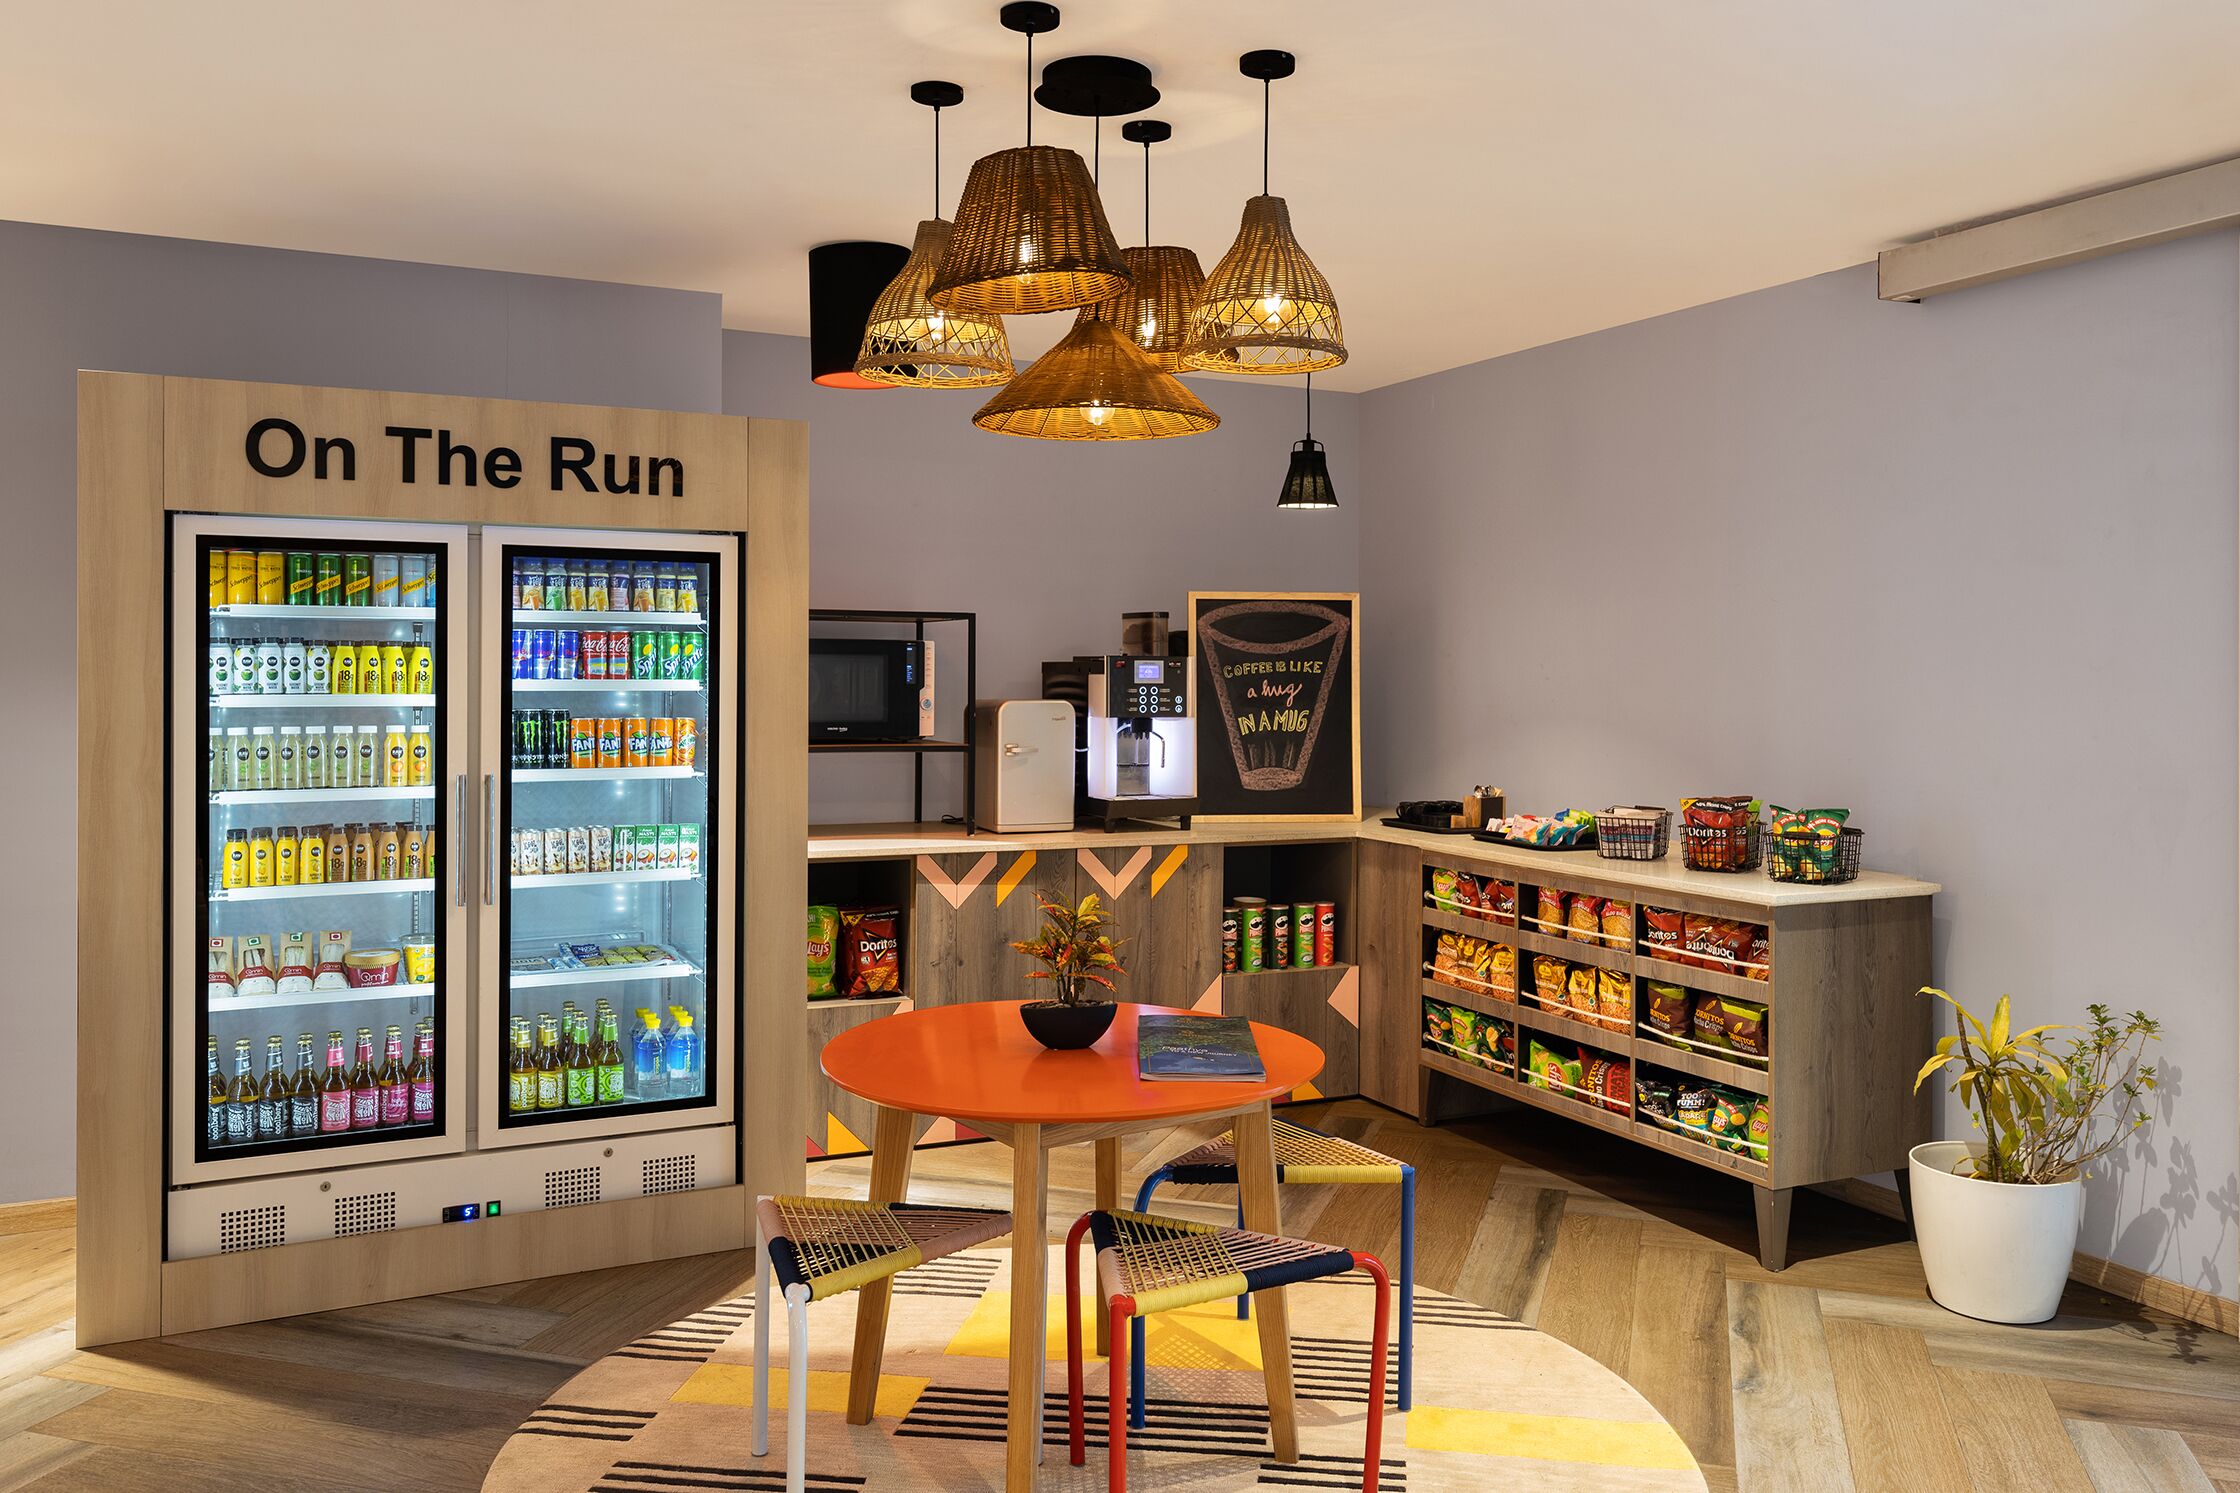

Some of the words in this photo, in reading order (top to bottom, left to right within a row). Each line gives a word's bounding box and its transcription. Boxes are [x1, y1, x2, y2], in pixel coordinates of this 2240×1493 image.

[245, 418, 356, 481] On
[385, 426, 523, 489] The
[550, 436, 684, 497] Run
[1222, 662, 1274, 678] COFFEE
[1290, 660, 1323, 674] LIKE
[1247, 687, 1258, 699] a
[1261, 679, 1303, 708] hug
[1238, 713, 1256, 736] IN
[1258, 710, 1272, 732] A
[1272, 709, 1310, 732] MUG
[572, 738, 595, 751] FANT
[1688, 828, 1727, 838] Doritos
[860, 939, 897, 952] Doritos
[360, 972, 389, 982] Qmin
